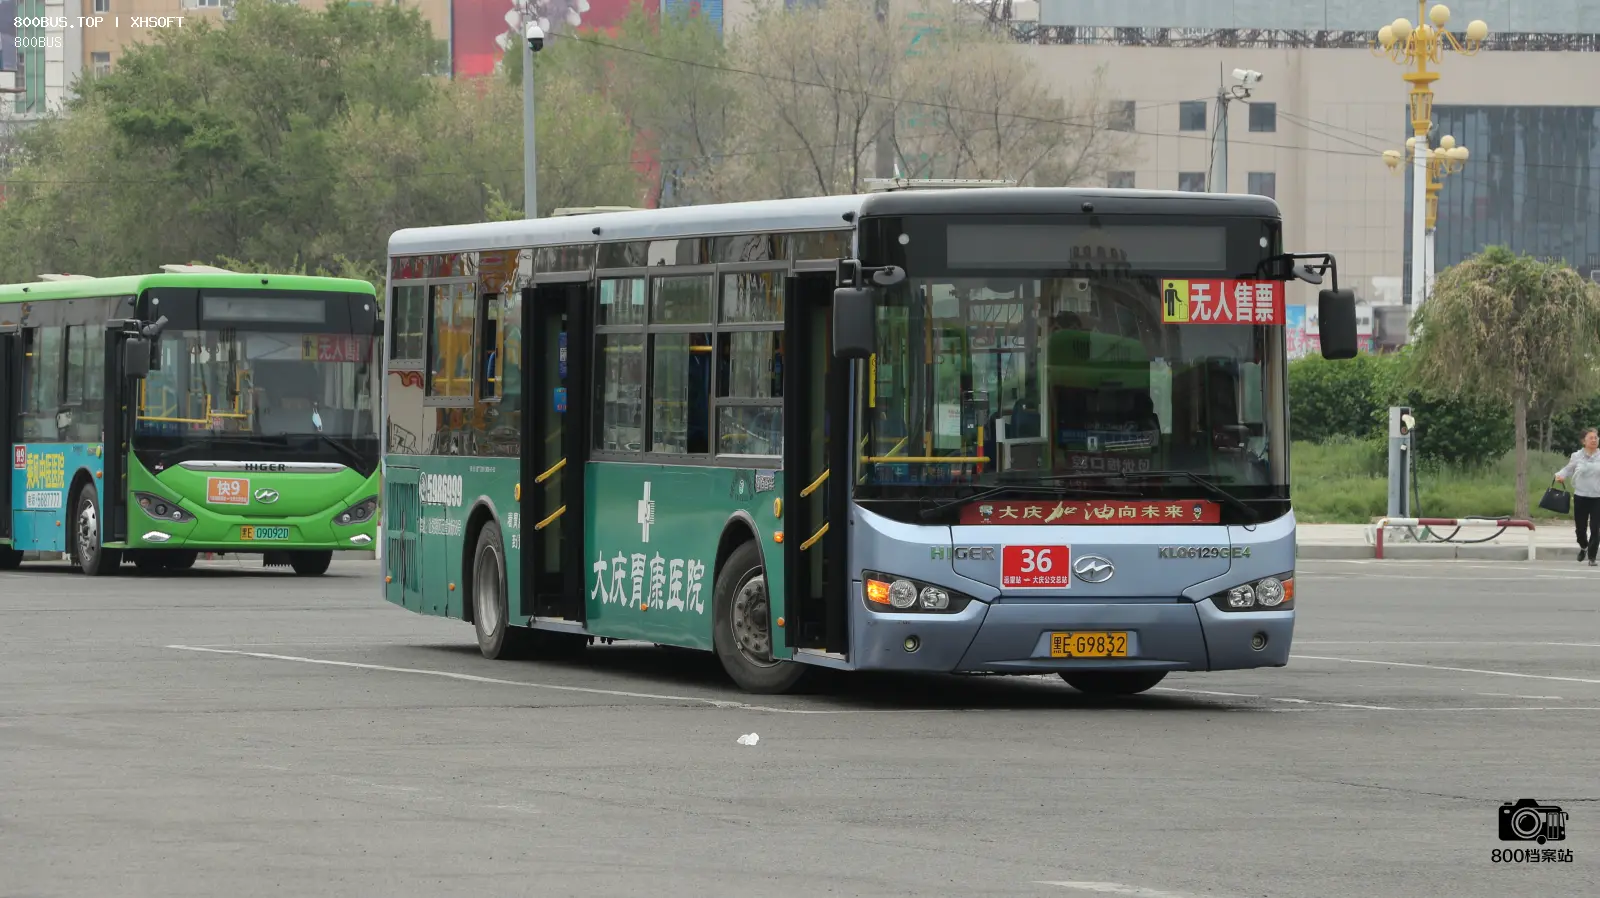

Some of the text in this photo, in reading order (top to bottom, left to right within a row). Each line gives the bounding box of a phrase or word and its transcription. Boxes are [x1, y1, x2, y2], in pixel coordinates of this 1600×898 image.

[1190, 281, 1274, 321] 无人售票
[244, 463, 286, 472] HIGER
[217, 480, 241, 497] 快9
[998, 501, 1184, 523] 大庆加油向未来
[930, 546, 995, 561] HIGER
[1020, 549, 1053, 573] 36
[1158, 546, 1251, 559] KLQ6129GE4
[591, 550, 705, 614] 大庆胃康医院
[1032, 576, 1068, 584] 大庆公交总站
